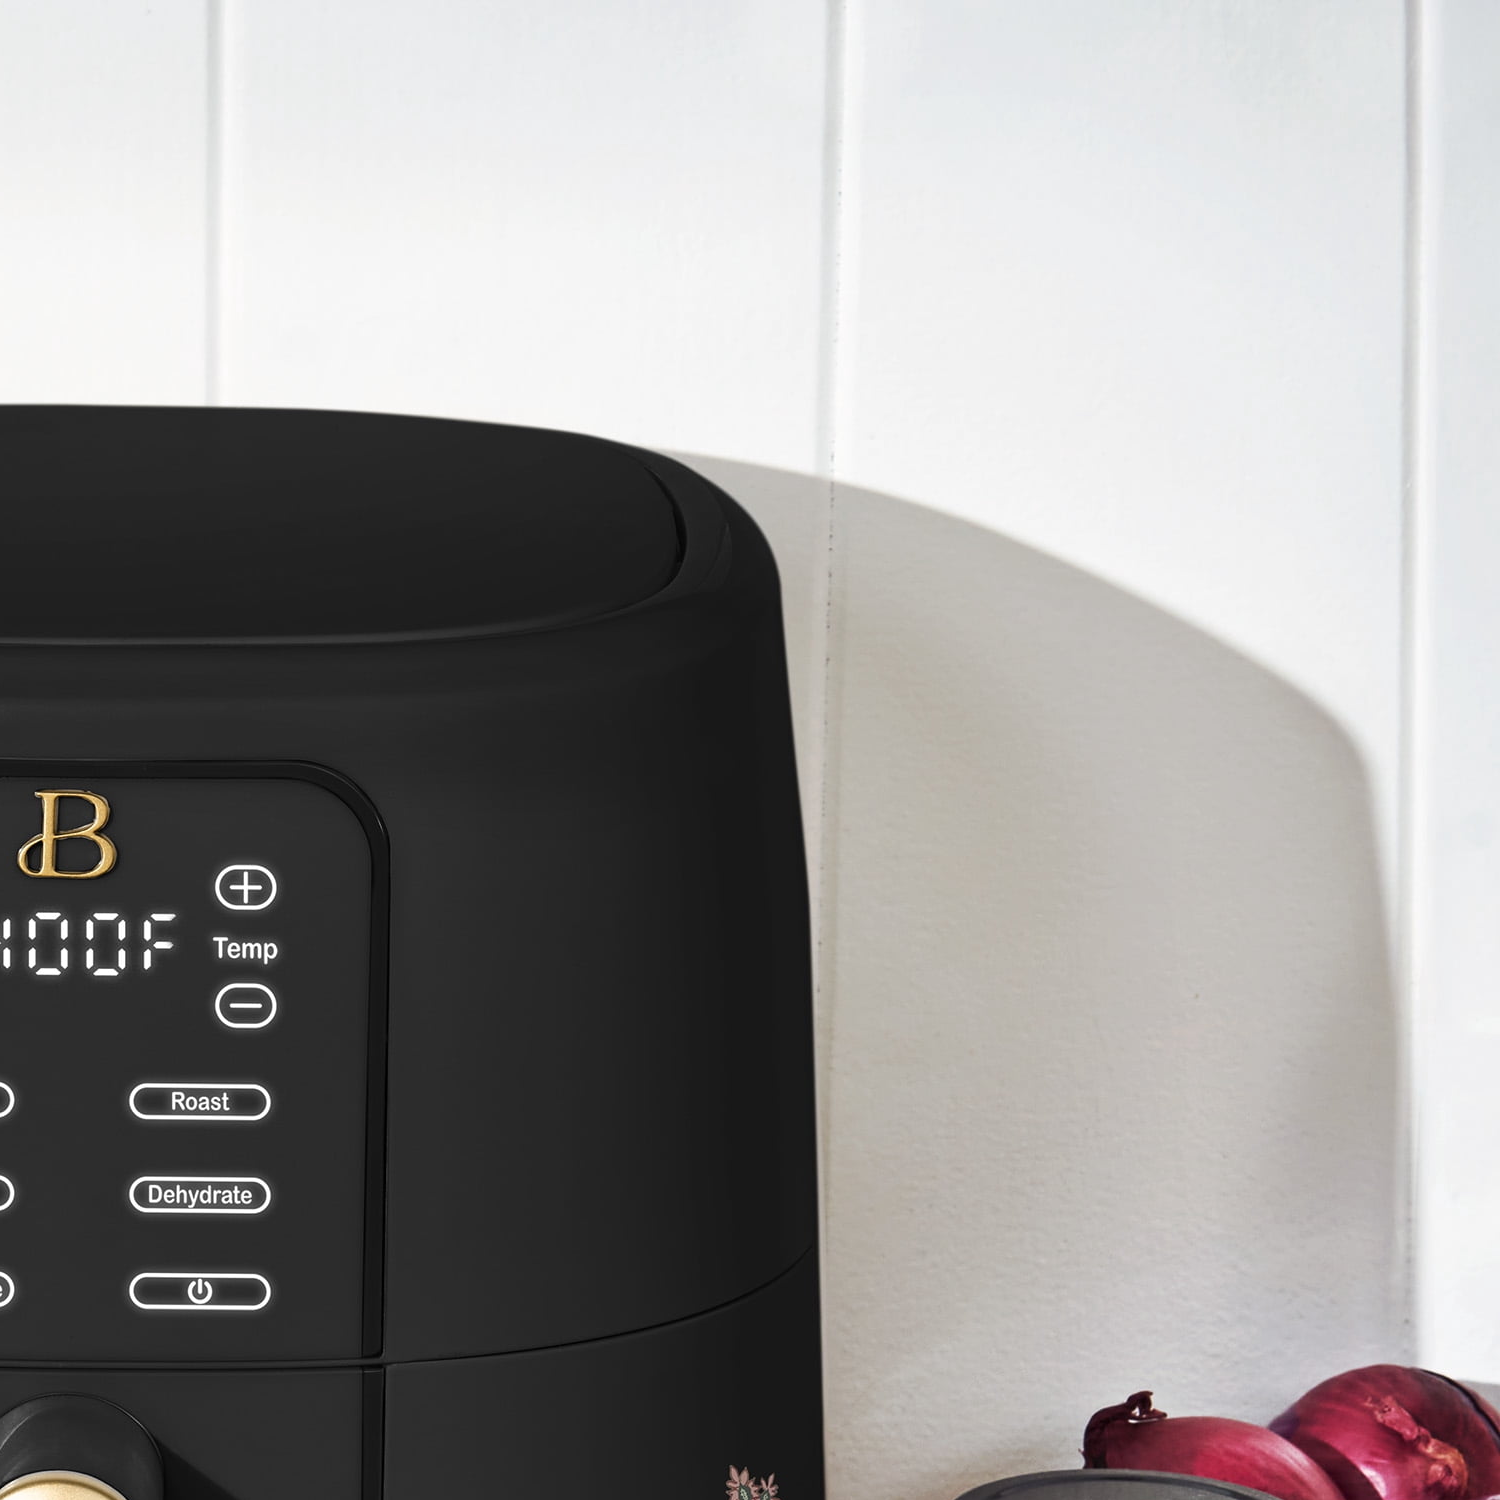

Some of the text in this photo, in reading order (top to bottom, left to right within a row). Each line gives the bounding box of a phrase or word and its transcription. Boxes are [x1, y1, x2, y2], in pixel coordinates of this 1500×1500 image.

[212, 936, 279, 965] Temp
[171, 1091, 230, 1111] Roast
[148, 1183, 253, 1208] Dehydrate
